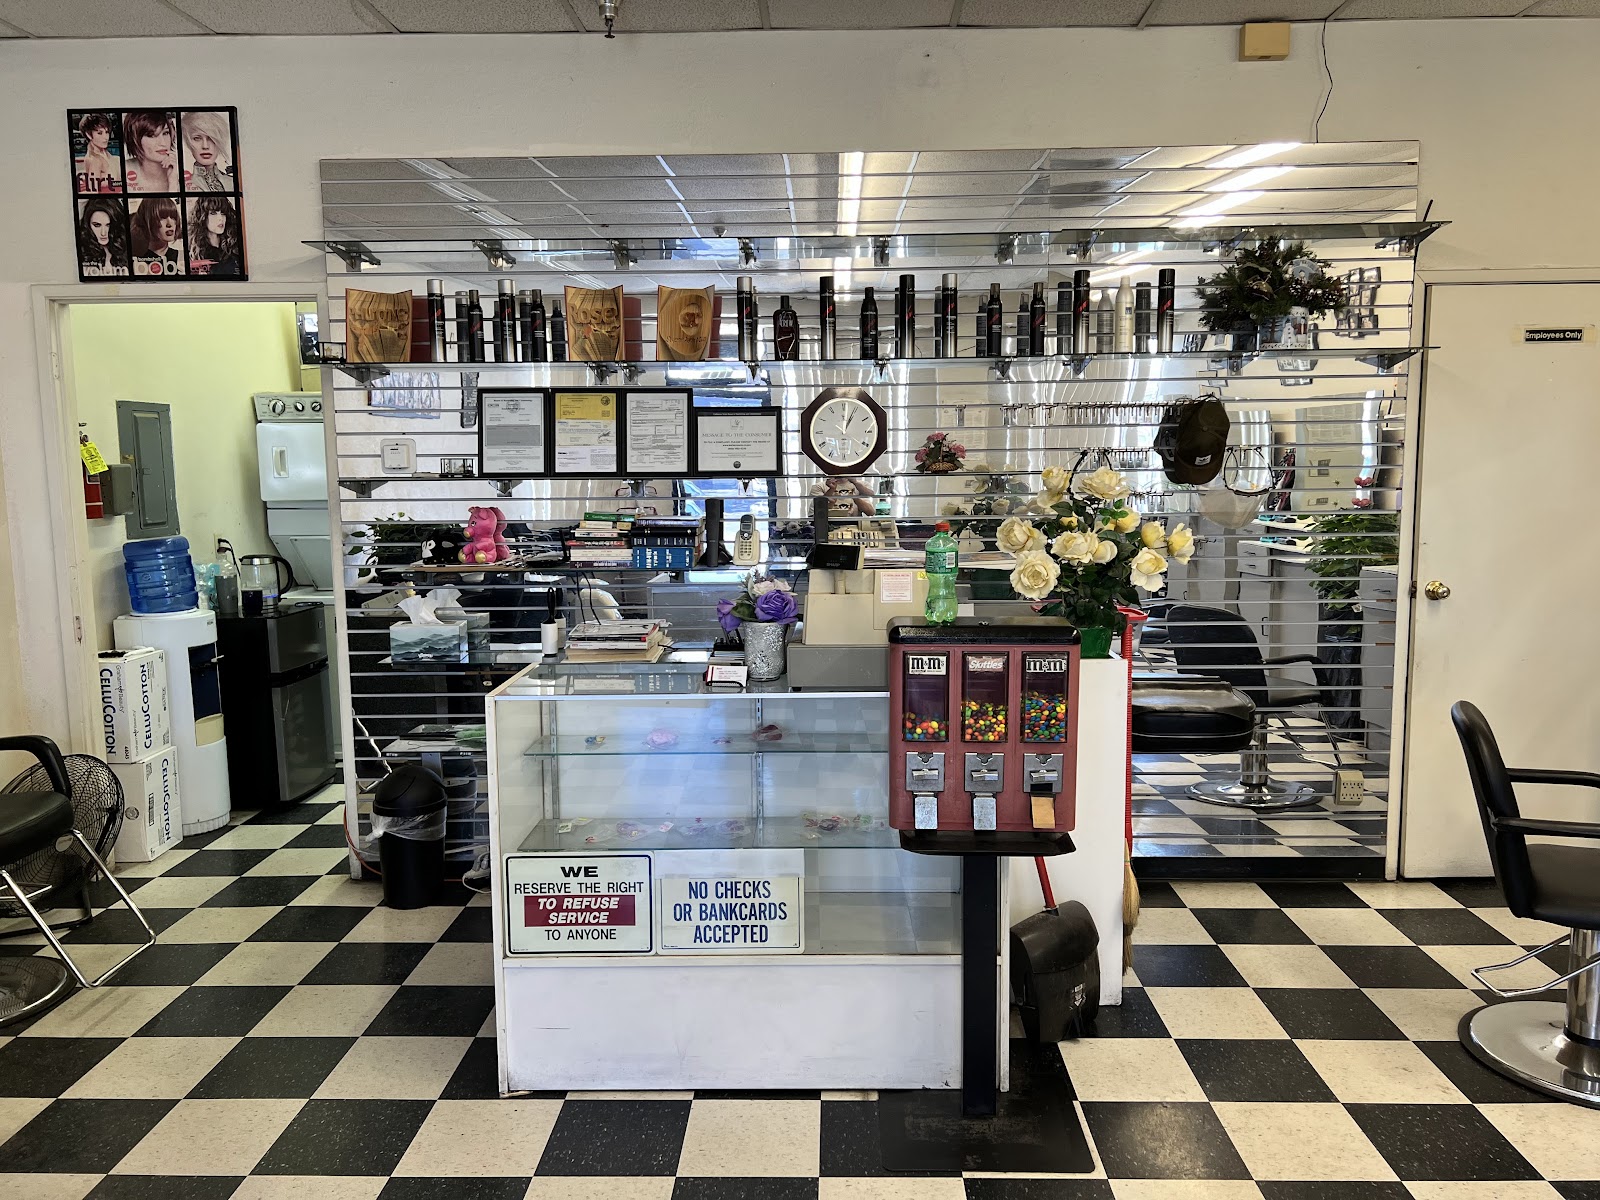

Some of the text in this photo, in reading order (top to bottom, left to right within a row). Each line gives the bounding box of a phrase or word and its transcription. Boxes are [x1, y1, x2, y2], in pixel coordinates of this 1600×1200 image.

[76, 172, 115, 192] flirt
[1526, 331, 1581, 340] Employees Only
[969, 660, 1004, 670] Skittles
[560, 866, 598, 878] WE
[514, 882, 644, 894] RESERVE THE RIGHT
[688, 880, 771, 900] NO CHECKS
[538, 897, 620, 910] TO REFUSE
[548, 912, 610, 924] SERVICE
[673, 902, 788, 922] OR BANKCARDS
[545, 928, 617, 940] TO ANYONE
[693, 925, 769, 944] ACCEPTED
